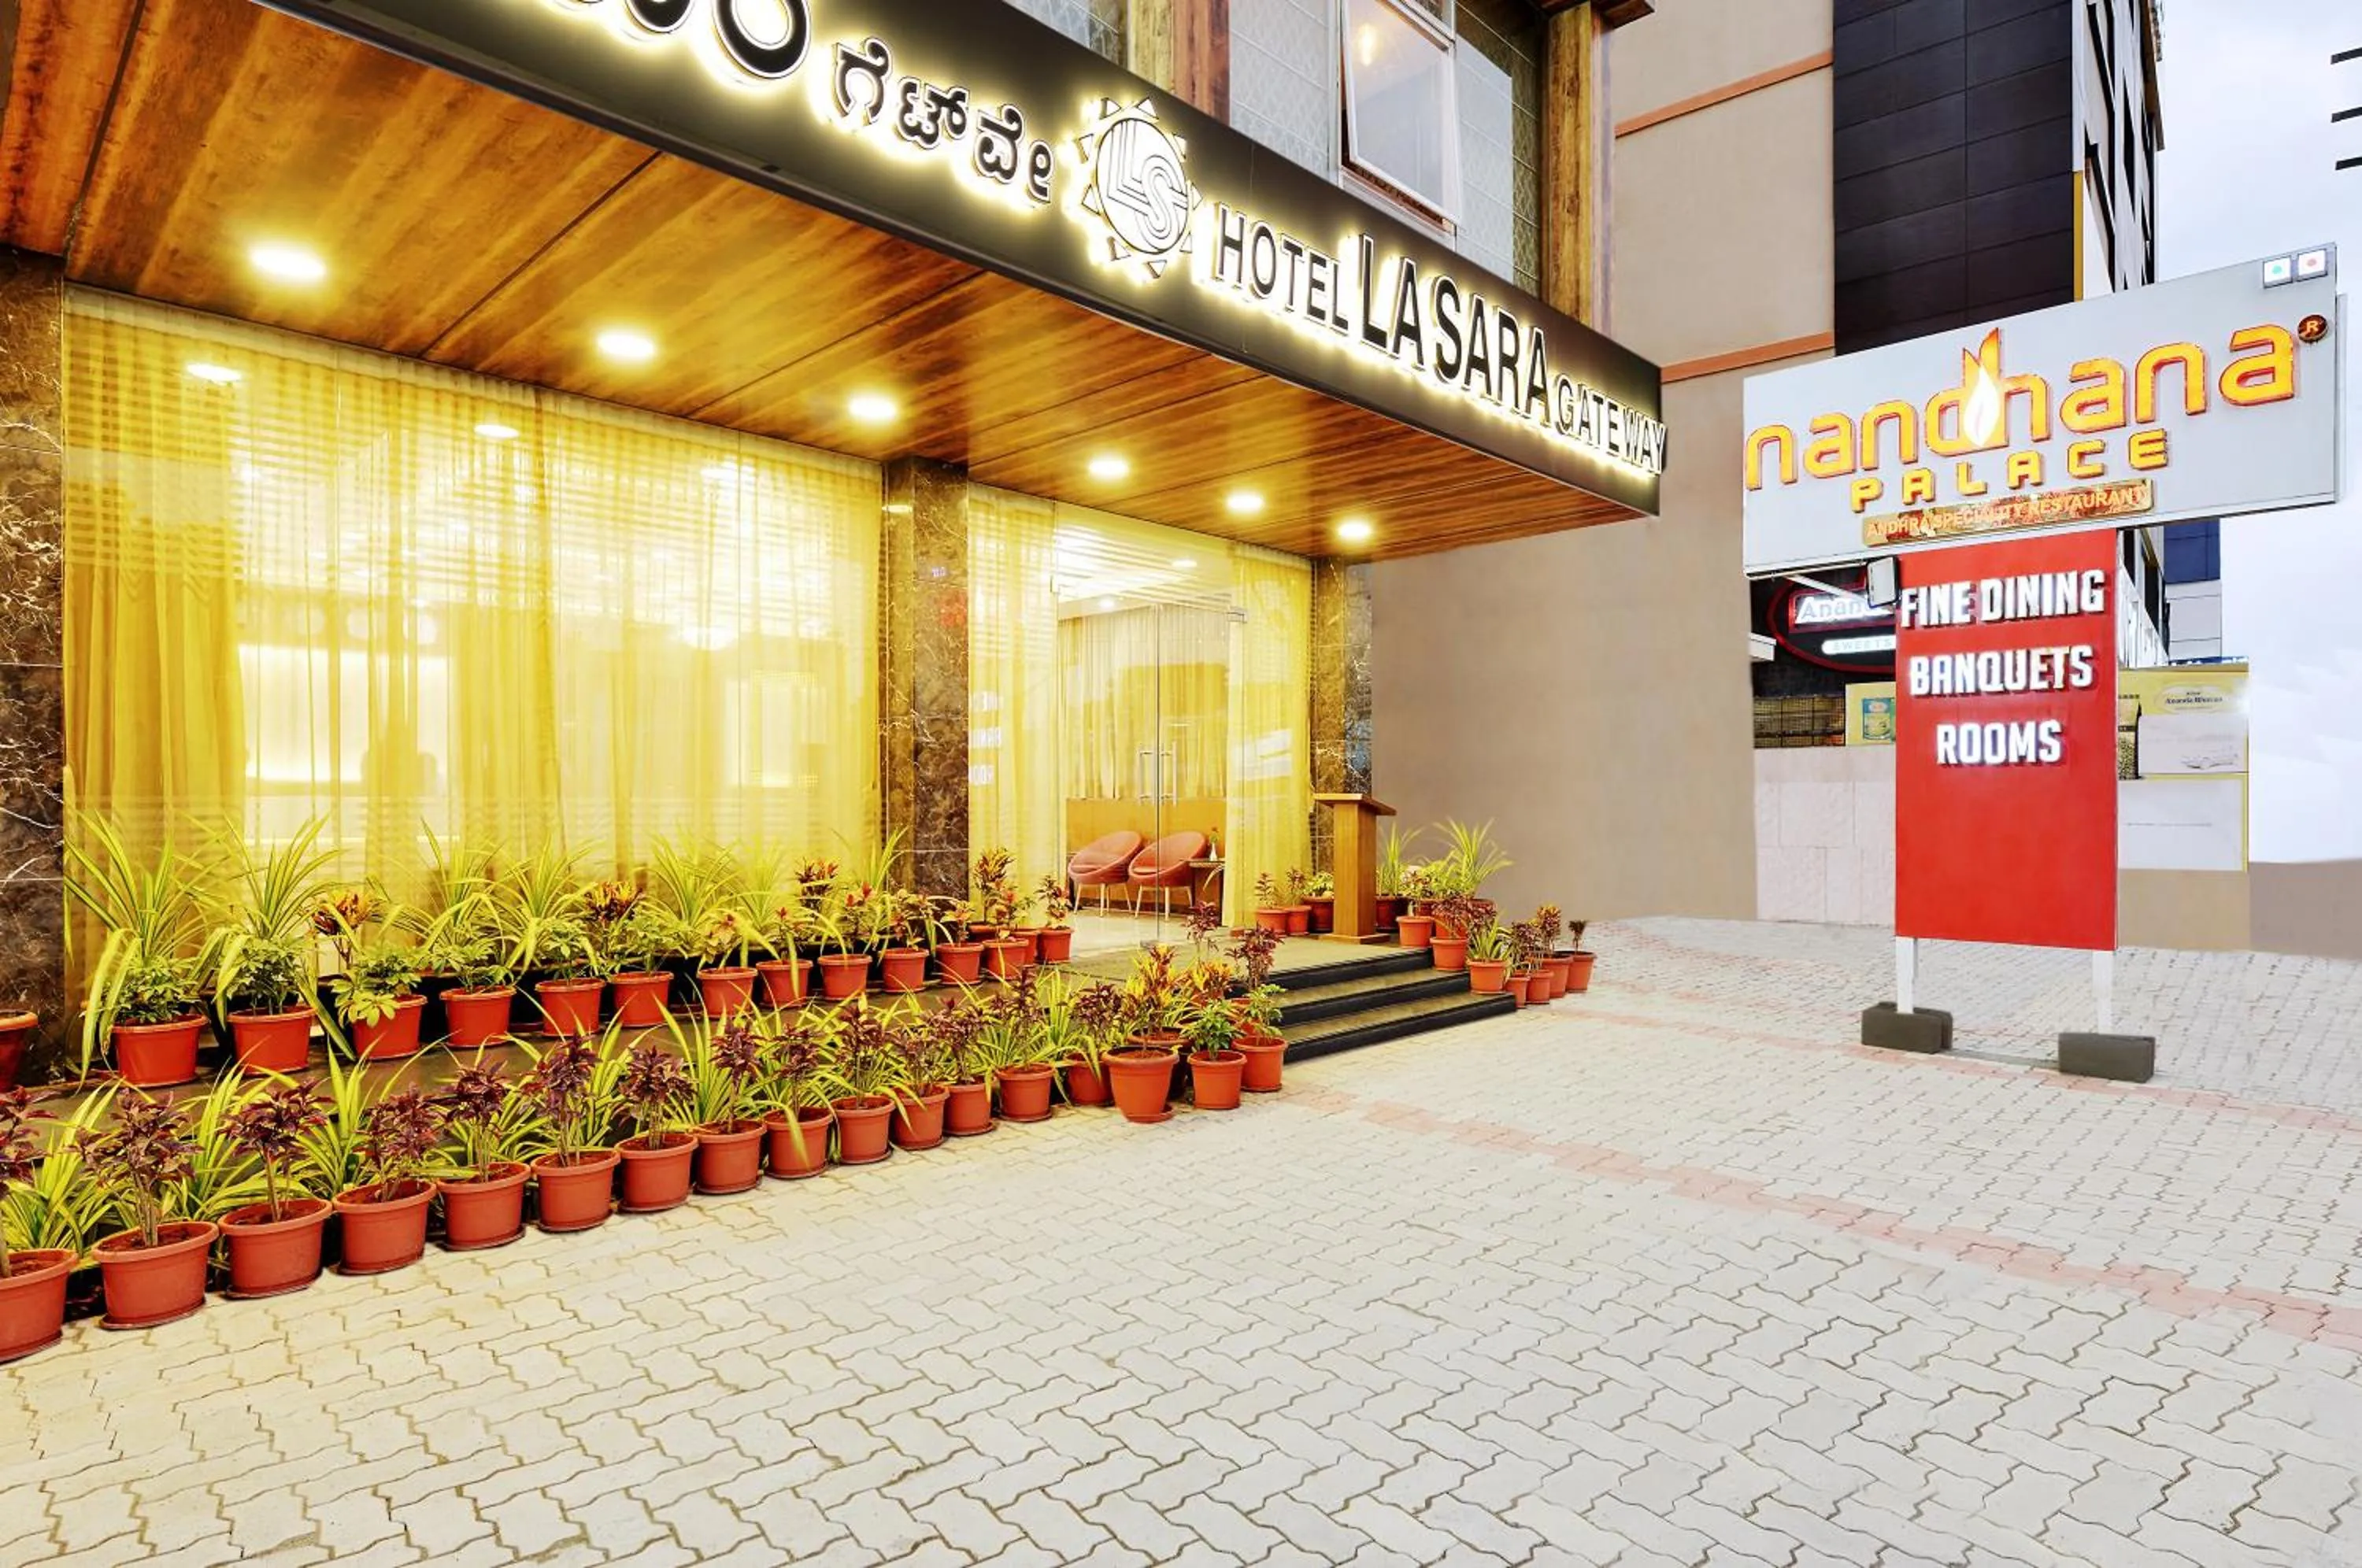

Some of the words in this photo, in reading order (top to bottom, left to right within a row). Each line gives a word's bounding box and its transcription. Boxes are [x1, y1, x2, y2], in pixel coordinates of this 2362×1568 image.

[1212, 202, 1349, 337] HOTEL
[1554, 374, 1668, 474] GATEWAY
[1744, 325, 2296, 490] nandhana
[1850, 428, 2169, 512] PALACE
[2026, 483, 2150, 515] RESTAURANT
[1900, 582, 1971, 628] FINE
[1980, 570, 2106, 617] DINING
[1908, 645, 2094, 697] BANQUETS
[1936, 719, 2063, 765] ROOMS
